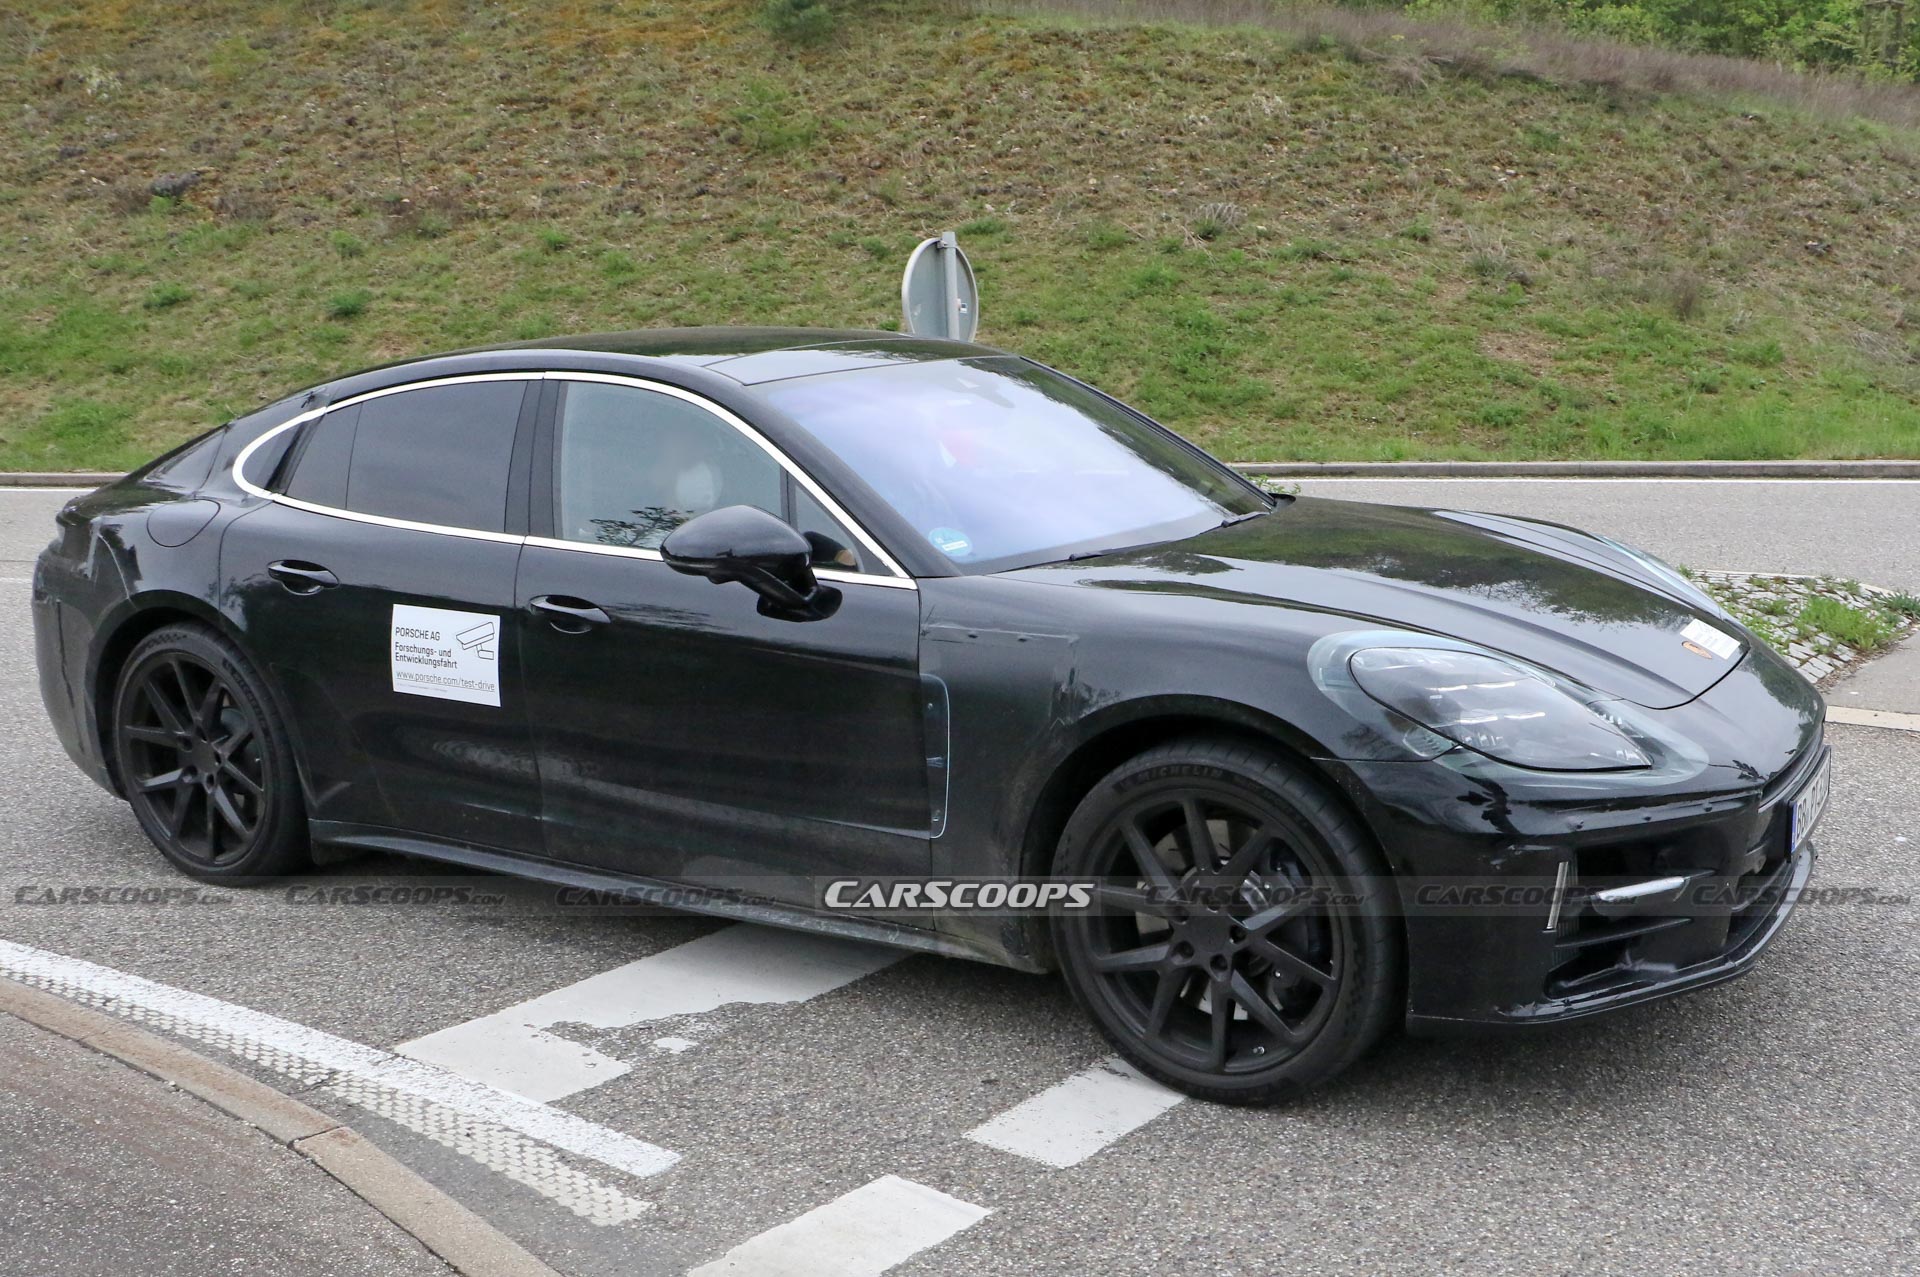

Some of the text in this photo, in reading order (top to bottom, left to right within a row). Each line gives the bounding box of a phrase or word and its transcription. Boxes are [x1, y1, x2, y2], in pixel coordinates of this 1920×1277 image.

[395, 626, 441, 641] PORSCHE AG
[395, 641, 452, 658] Forschungs- und
[395, 652, 458, 669] Entwicklungsfahrt
[396, 670, 496, 692] www.porsche.com/test-drive
[1138, 765, 1224, 782] MICHELIN
